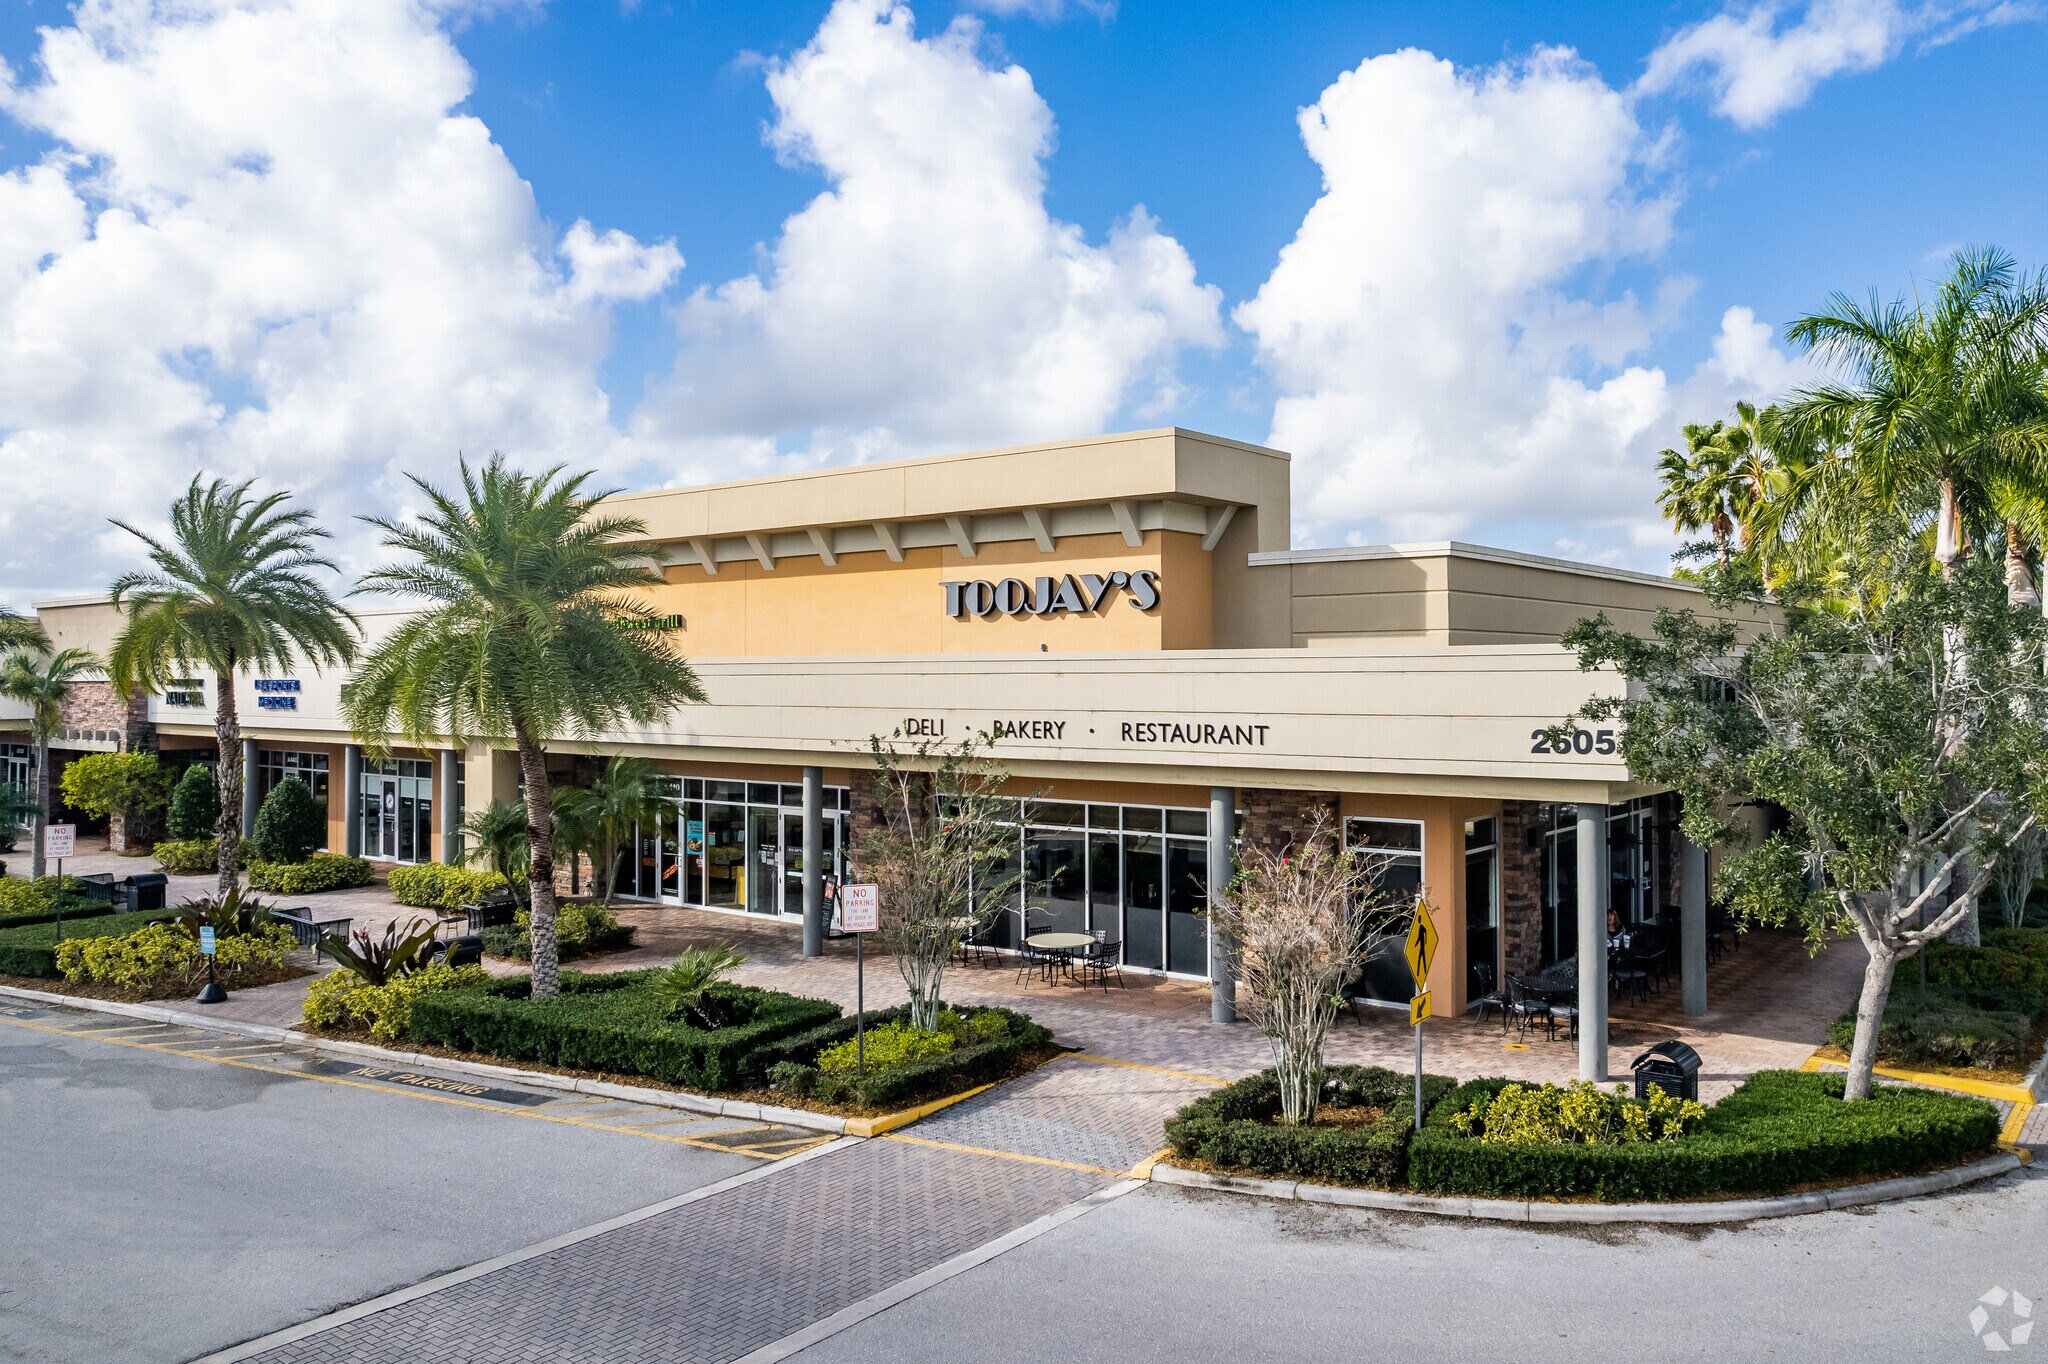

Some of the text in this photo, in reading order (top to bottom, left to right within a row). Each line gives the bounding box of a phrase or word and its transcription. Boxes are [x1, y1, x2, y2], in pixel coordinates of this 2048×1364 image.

[939, 569, 1161, 618] TOOJAY'S
[268, 680, 300, 692] SPORTS
[906, 718, 1270, 746] DELI BAKERY RESTAURANT
[1531, 729, 1616, 755] 2605
[853, 889, 866, 897] NO
[350, 1067, 490, 1095] NO PARKING
